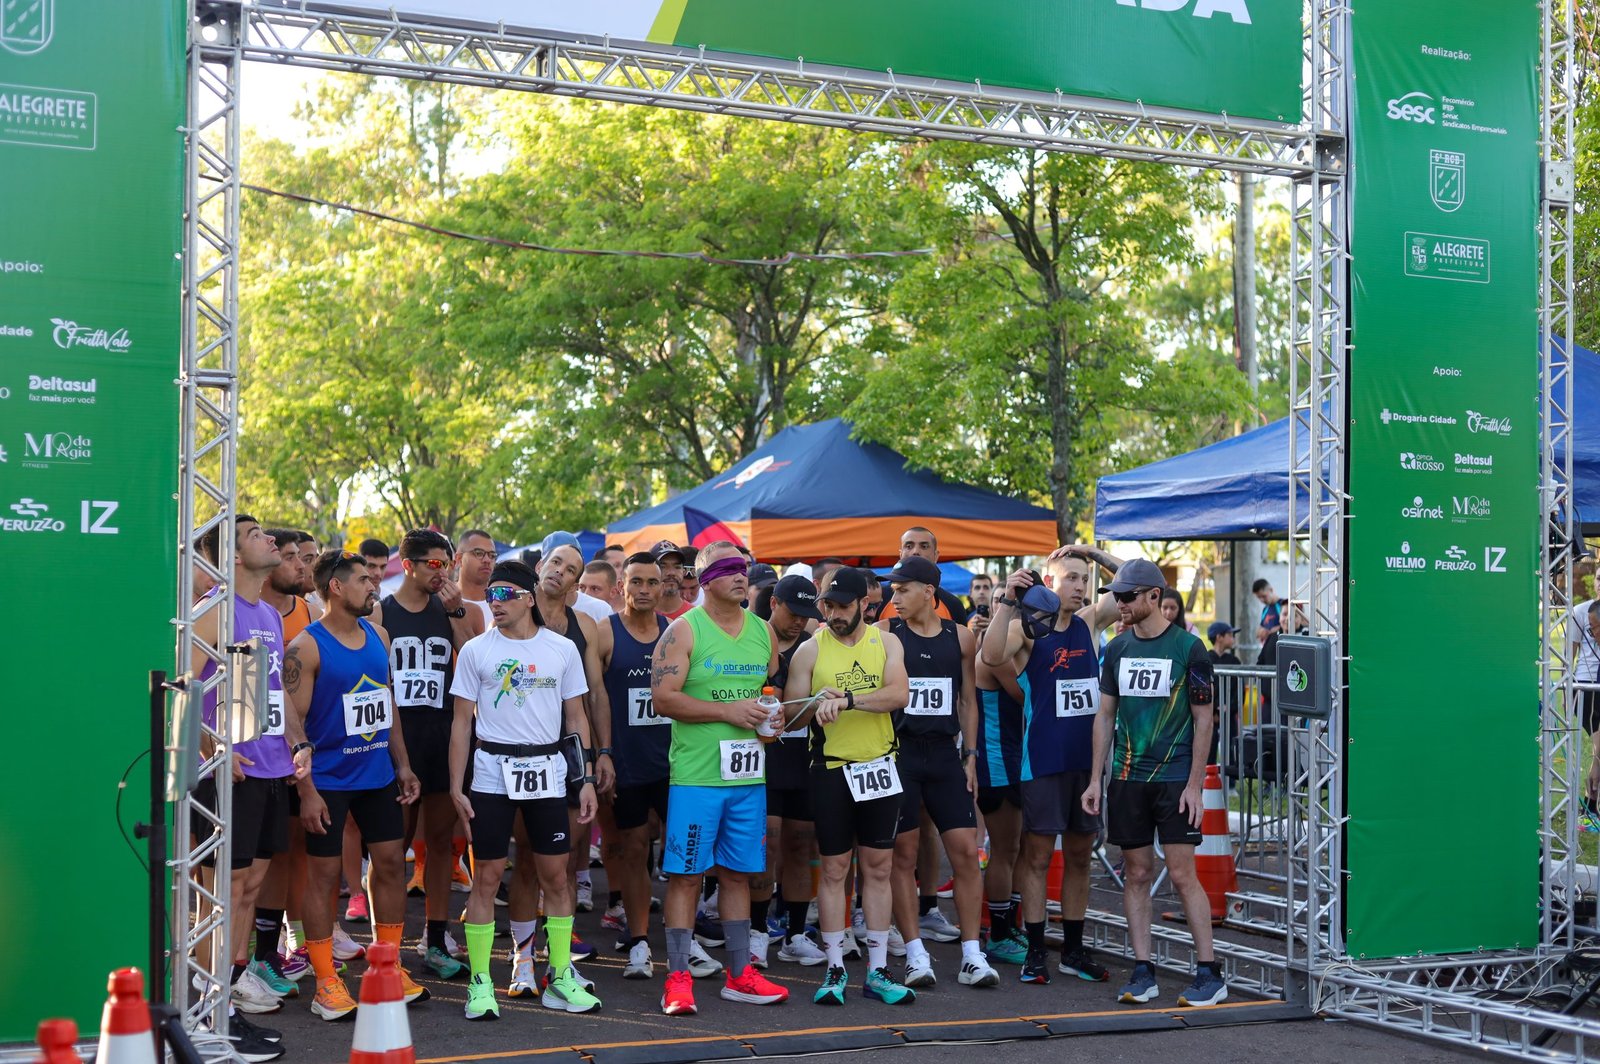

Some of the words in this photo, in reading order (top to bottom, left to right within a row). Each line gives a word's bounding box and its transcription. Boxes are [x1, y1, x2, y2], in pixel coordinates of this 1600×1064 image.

[1421, 44, 1472, 60] Realização:
[0, 94, 87, 119] ALEGRETE
[1442, 96, 1475, 107] Fecomércio
[1442, 120, 1471, 130] Sindicatos
[1471, 124, 1508, 135] Empresariais
[1433, 242, 1484, 260] ALEGRETE
[1434, 257, 1485, 268] PREFEITURA
[1433, 366, 1462, 377] Apoio:
[29, 375, 96, 393] Deltasul
[41, 395, 61, 403] mais
[62, 396, 76, 404] por
[77, 396, 95, 404] você
[1393, 412, 1427, 424] Drogaria
[1429, 415, 1457, 425] Cidade
[1416, 461, 1445, 472] ROSSO
[1454, 453, 1493, 466] Deltasul
[80, 500, 119, 534] IZ
[1385, 556, 1426, 569] VIELMO
[1435, 560, 1476, 571] PERUZZO
[1485, 547, 1507, 572] IZ
[835, 669, 864, 688] PRO
[1128, 669, 1162, 690] 767
[402, 679, 438, 700] 726
[712, 689, 736, 700] BOA
[909, 688, 943, 709] 719
[1061, 689, 1093, 710] 751
[352, 701, 386, 727] 704
[343, 746, 362, 754] GRUPO
[730, 751, 760, 773] 811
[511, 769, 548, 792] 781
[853, 768, 893, 794] 746
[868, 790, 888, 799] GELSON
[684, 824, 698, 873] VANDES
